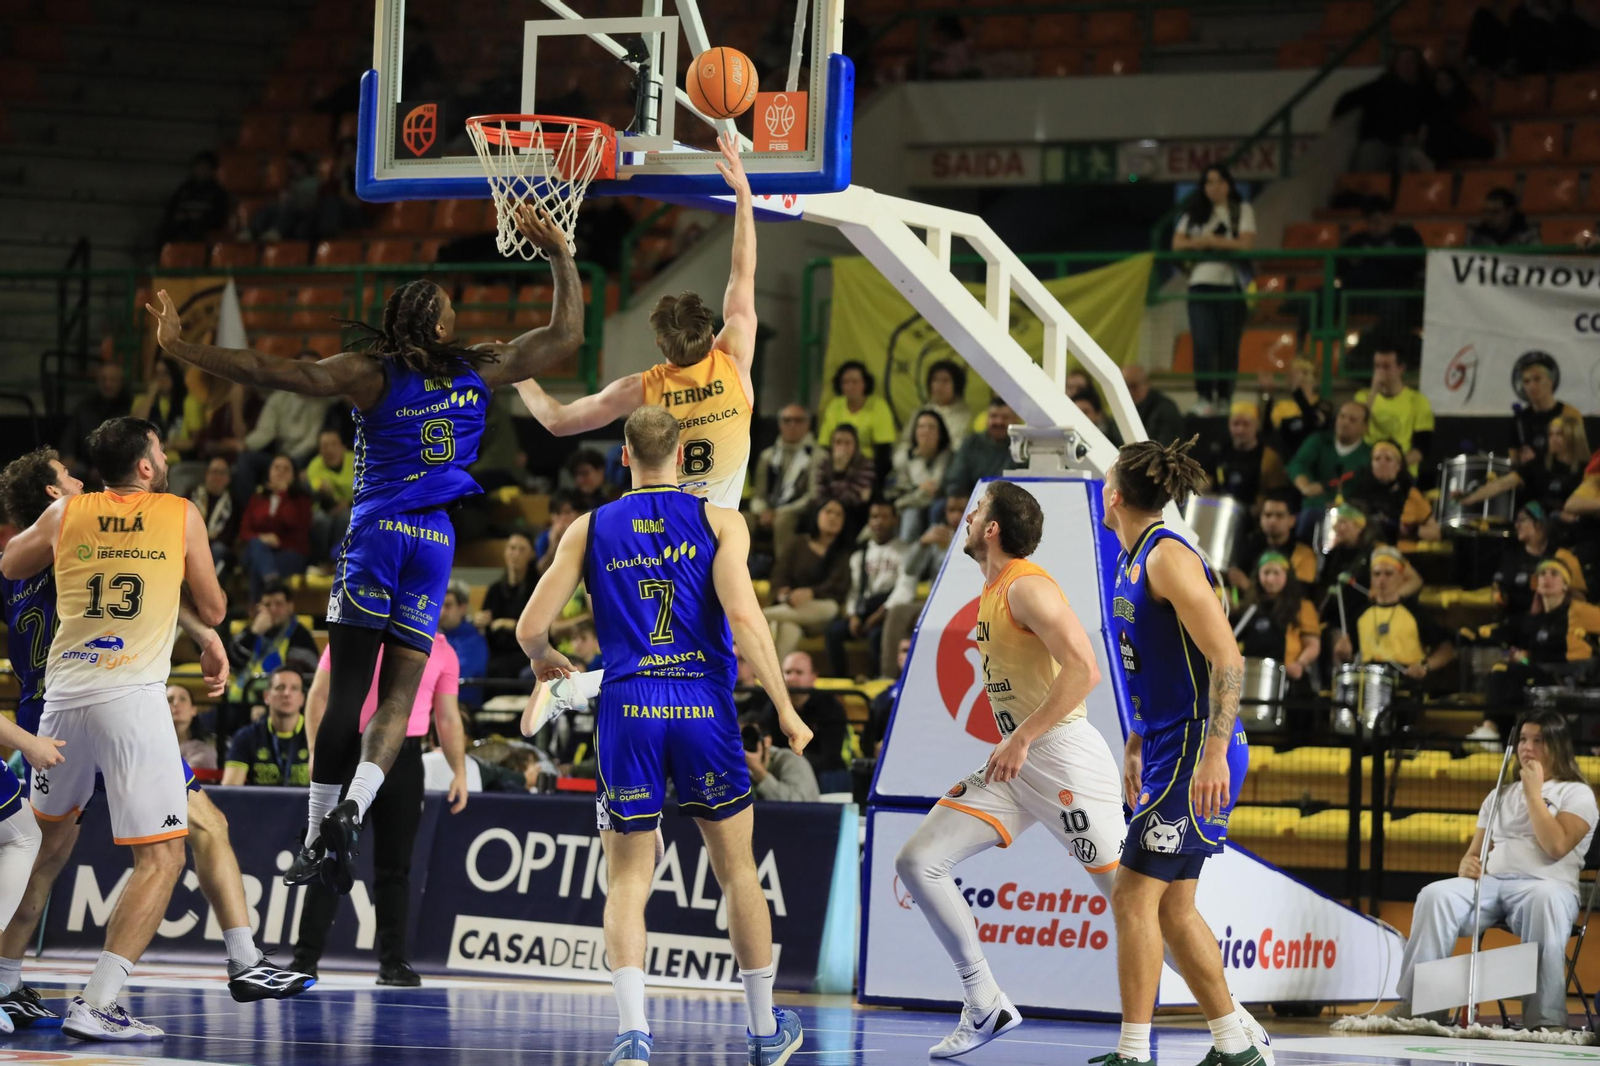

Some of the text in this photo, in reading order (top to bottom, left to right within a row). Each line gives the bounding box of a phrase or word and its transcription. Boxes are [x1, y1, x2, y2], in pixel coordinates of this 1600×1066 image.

[769, 143, 788, 151] FEB
[932, 149, 1025, 179] SAIDA
[1452, 255, 1600, 287] Vilanov
[662, 380, 724, 408] TERINS
[679, 408, 739, 430] BEREÓLICA
[421, 418, 455, 465] 9
[682, 438, 715, 476] 8
[97, 511, 144, 533] VILÁ
[97, 548, 167, 560] IBEREÓLICA
[606, 553, 663, 572] cloud.gal
[83, 572, 145, 620] 13
[638, 578, 675, 646] 7
[16, 606, 60, 672] 2
[985, 678, 1012, 693] rural
[622, 704, 715, 719] TRANSITERIA
[619, 791, 650, 801] OURENSE
[1059, 808, 1091, 834] 10
[466, 827, 787, 930] OPTIALA
[974, 915, 1108, 951] aradelo
